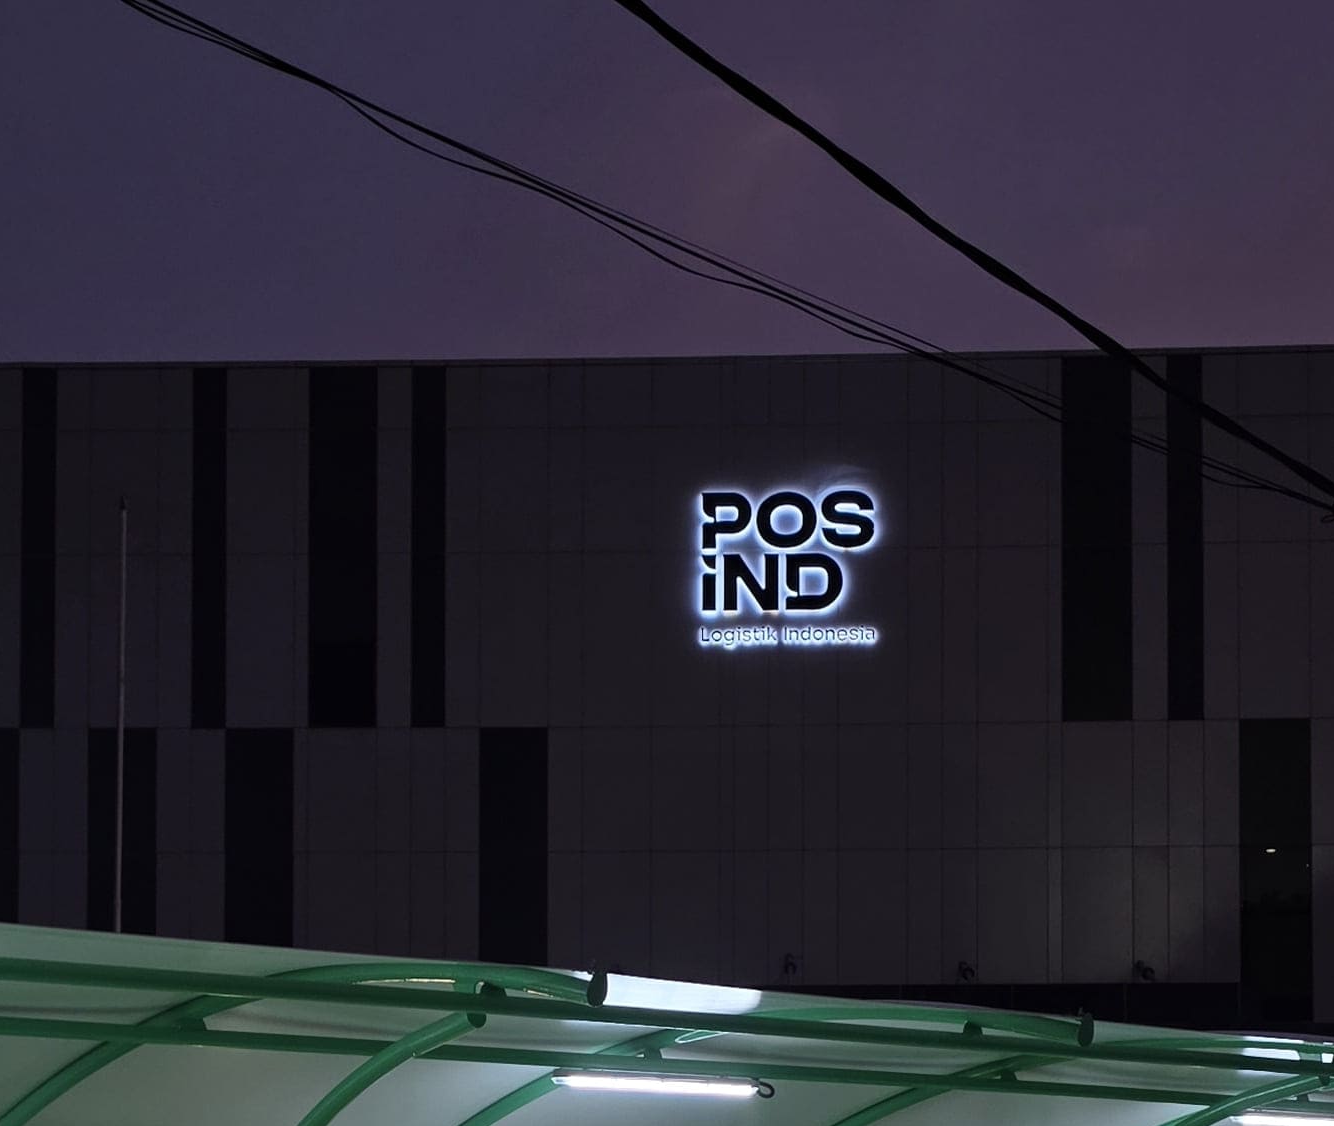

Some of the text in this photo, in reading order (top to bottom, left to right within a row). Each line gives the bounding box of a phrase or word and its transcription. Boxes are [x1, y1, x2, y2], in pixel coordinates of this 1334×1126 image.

[701, 489, 875, 549] POS
[700, 625, 876, 649] Logistik Indonesia
